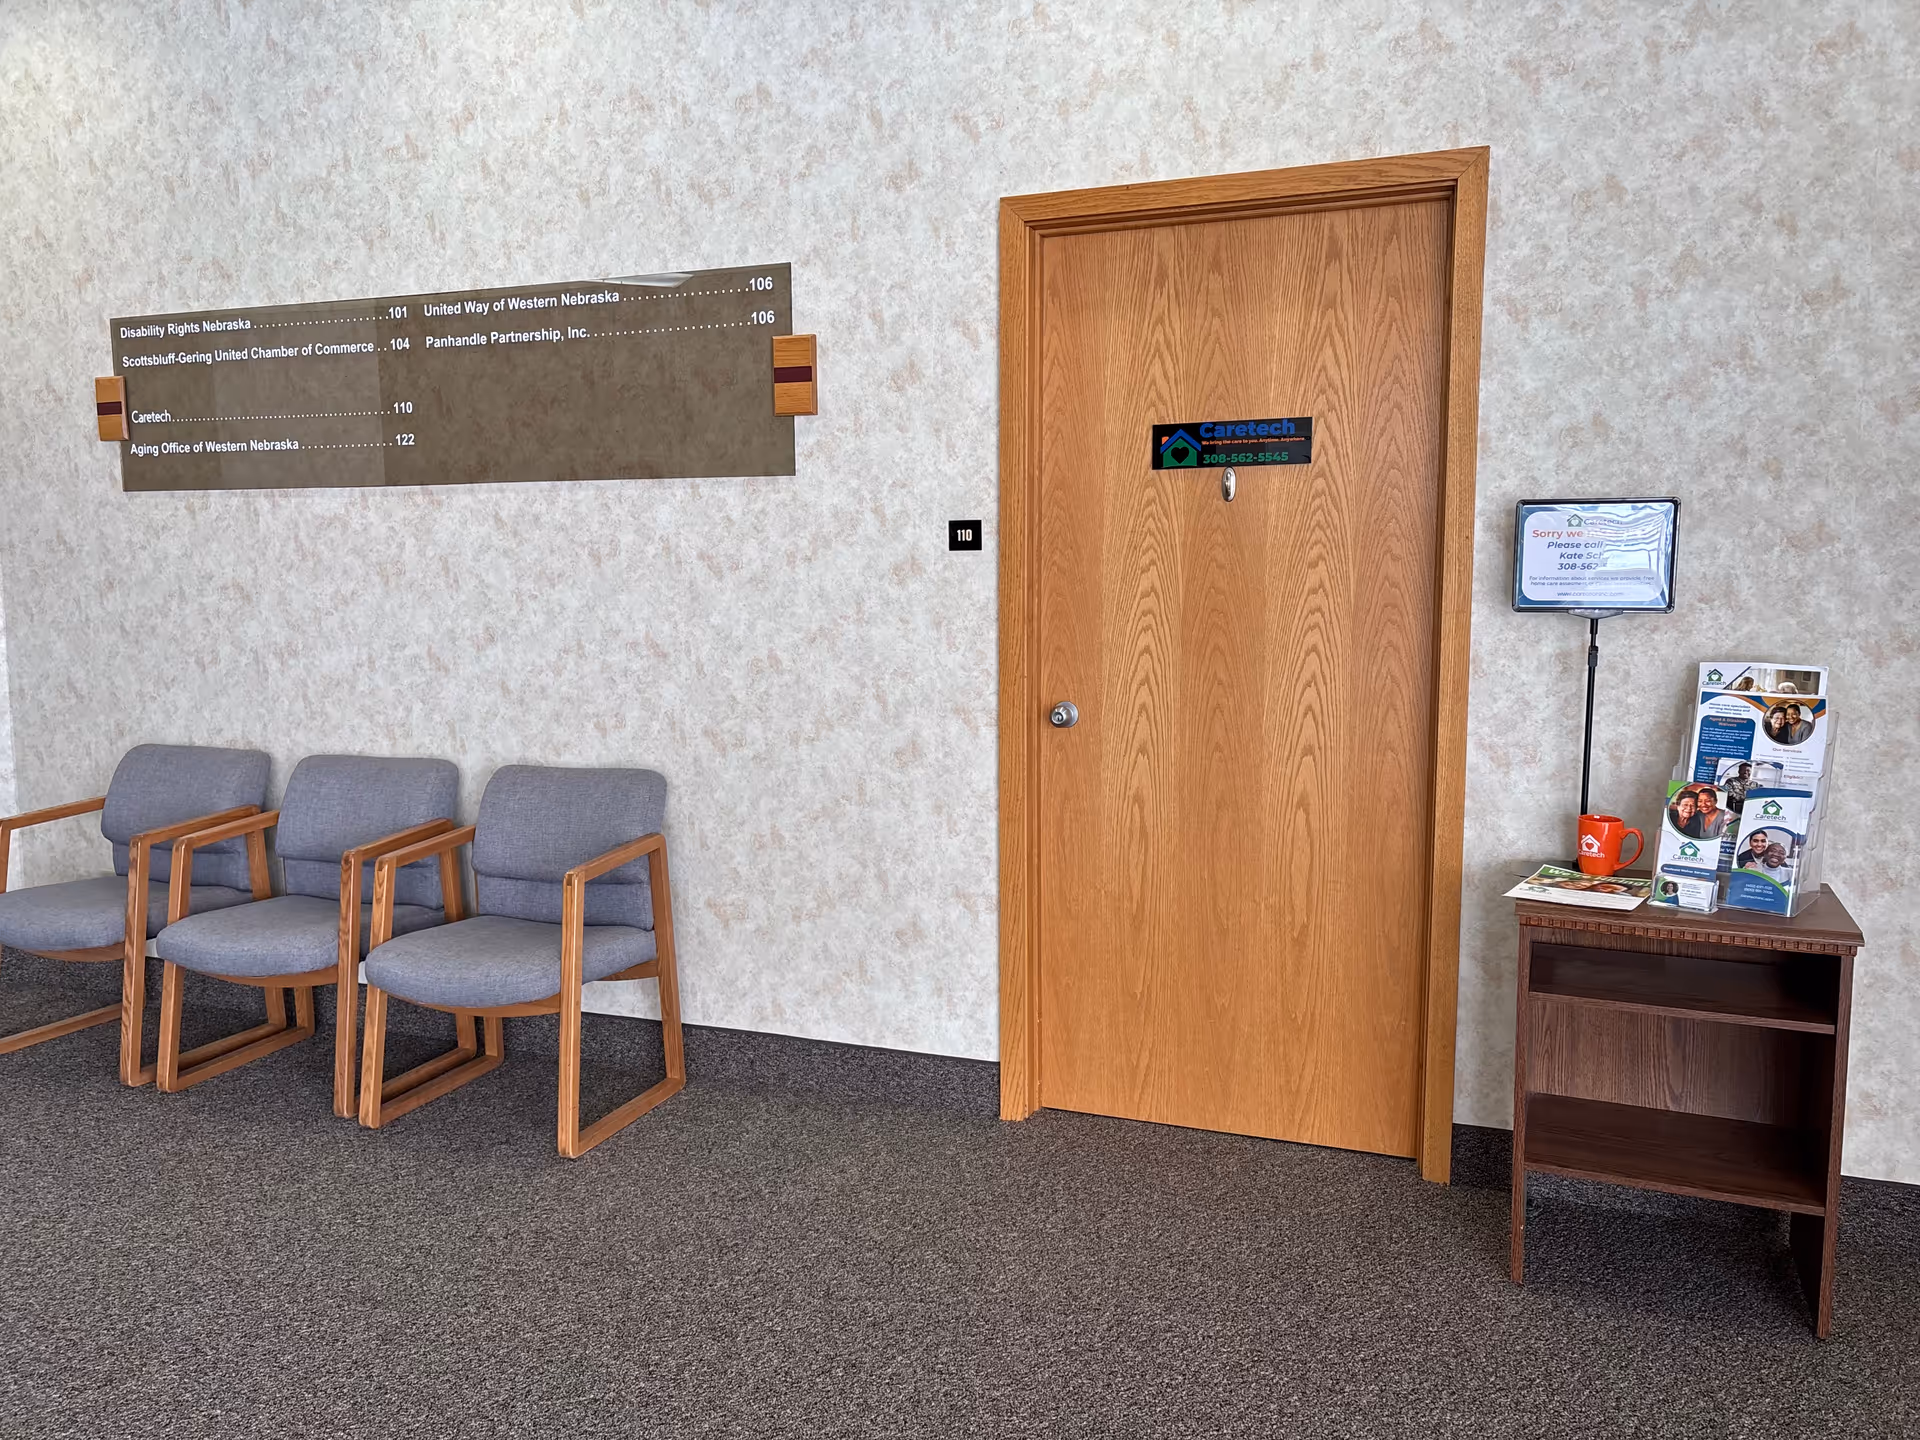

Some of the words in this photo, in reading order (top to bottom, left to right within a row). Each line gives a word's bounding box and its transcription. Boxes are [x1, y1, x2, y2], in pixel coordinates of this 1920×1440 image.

[424, 299, 462, 317] United
[464, 295, 489, 315] Way
[493, 294, 505, 312] of
[507, 293, 558, 311] Western
[560, 289, 620, 306] Nebraska
[748, 276, 773, 292] 106
[119, 325, 165, 339] Disability
[167, 322, 200, 337] Rights
[202, 318, 251, 333] Nebraska
[388, 306, 408, 319] 101
[425, 332, 489, 349] Panhandle
[490, 328, 564, 346] Partnership,
[750, 310, 775, 326] 106
[122, 351, 212, 368] Scottsbluff-Gering
[214, 347, 249, 362] United
[250, 345, 299, 360] Chamber
[301, 343, 313, 356] of
[315, 341, 374, 356] Commerce
[389, 337, 411, 351] 104
[131, 410, 171, 424] Caretech
[393, 401, 413, 414] 110
[1200, 418, 1296, 439] Caretech
[130, 442, 159, 457] Aging
[160, 441, 191, 455] Office
[192, 440, 204, 454] of
[205, 440, 248, 453] Western
[249, 438, 299, 451] Nebraska
[395, 433, 415, 446] 122
[1203, 451, 1289, 465] 308-562-5545
[956, 528, 973, 542] 110
[1532, 529, 1563, 540] Sorry
[1566, 530, 1584, 538] we
[1547, 541, 1582, 549] Please
[1584, 541, 1604, 549] call
[1559, 552, 1584, 560] Kate
[1757, 813, 1788, 822] Caretech
[1578, 849, 1605, 858] Caretech
[1672, 854, 1704, 863] Caretech
